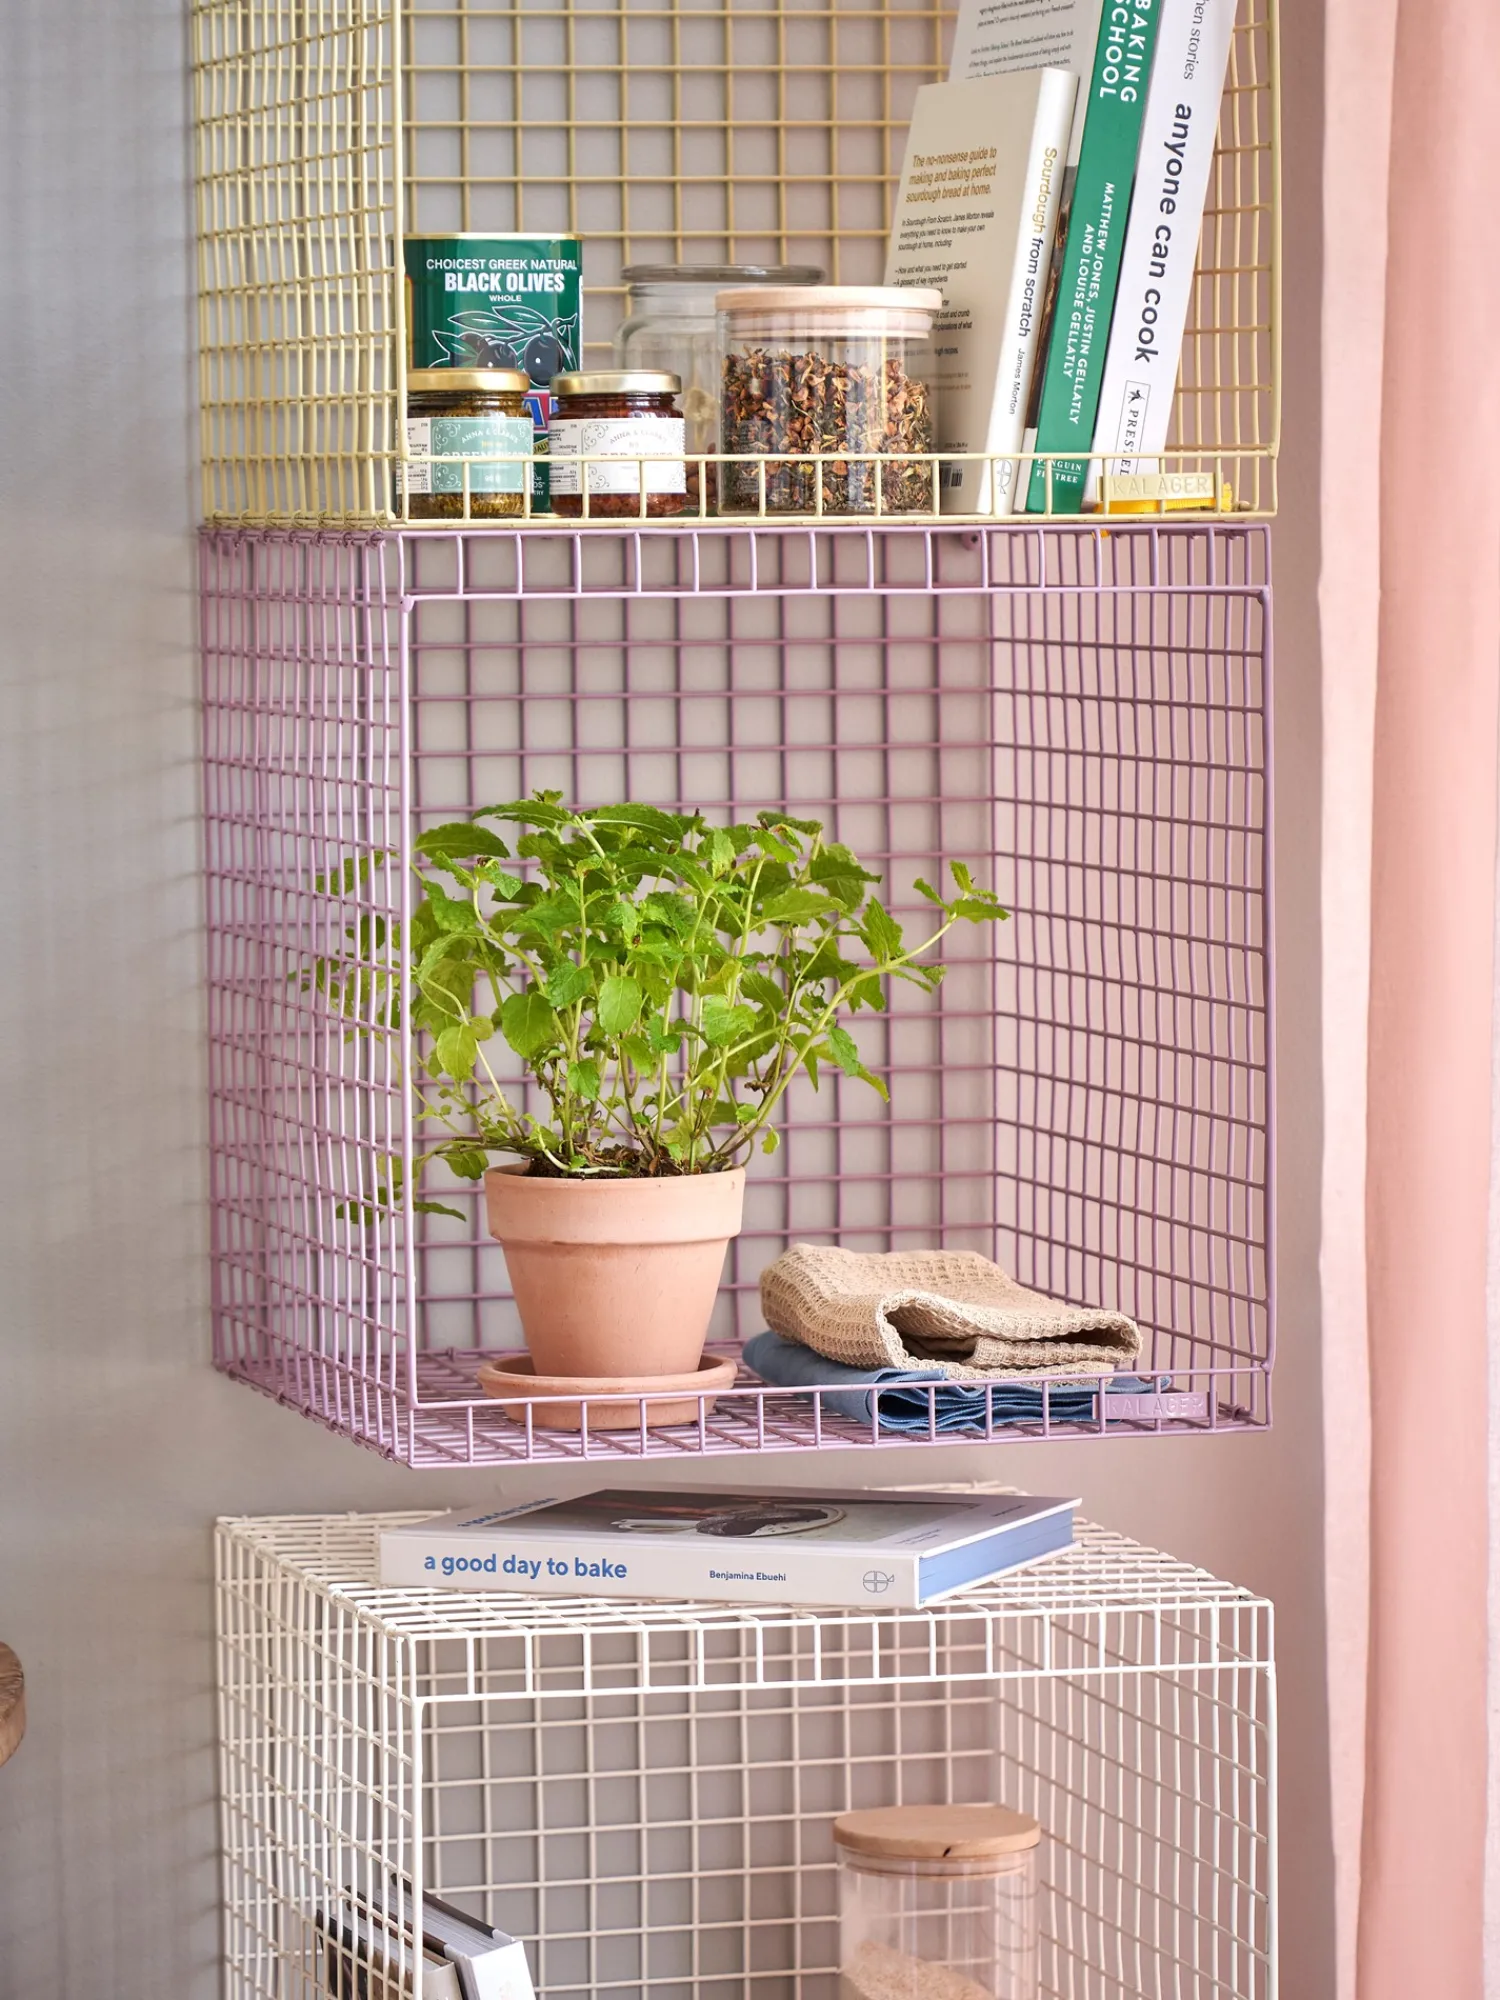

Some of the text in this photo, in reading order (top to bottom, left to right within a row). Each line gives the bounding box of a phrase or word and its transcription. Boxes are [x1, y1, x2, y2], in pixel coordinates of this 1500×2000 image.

[1120, 0, 1151, 102] BAKING
[1184, 28, 1201, 80] stories
[913, 146, 997, 168] The no-nonsense guide to
[909, 164, 997, 186] making and baking perfect
[906, 186, 941, 203] sourdough
[942, 184, 961, 199] bread
[962, 184, 970, 197] at
[1018, 147, 1057, 337] Sourdough from scratch
[1134, 103, 1192, 363] anyone can cook
[426, 258, 578, 270] CHOICEST GREEK NATURAL
[445, 273, 565, 292] BLACK OLIVES
[1063, 224, 1095, 378] AND LOUISE GELLATLY
[1069, 182, 1115, 424] MATTHEW JONES, JUSTIN GELLATLY
[1009, 348, 1025, 415] James Morton
[461, 430, 484, 444] ANNA
[1037, 458, 1082, 471] PNGUIN
[1055, 472, 1079, 484] TREE
[424, 1553, 628, 1579] a good day to bake
[709, 1570, 786, 1582] Benjamina Ebuehi
